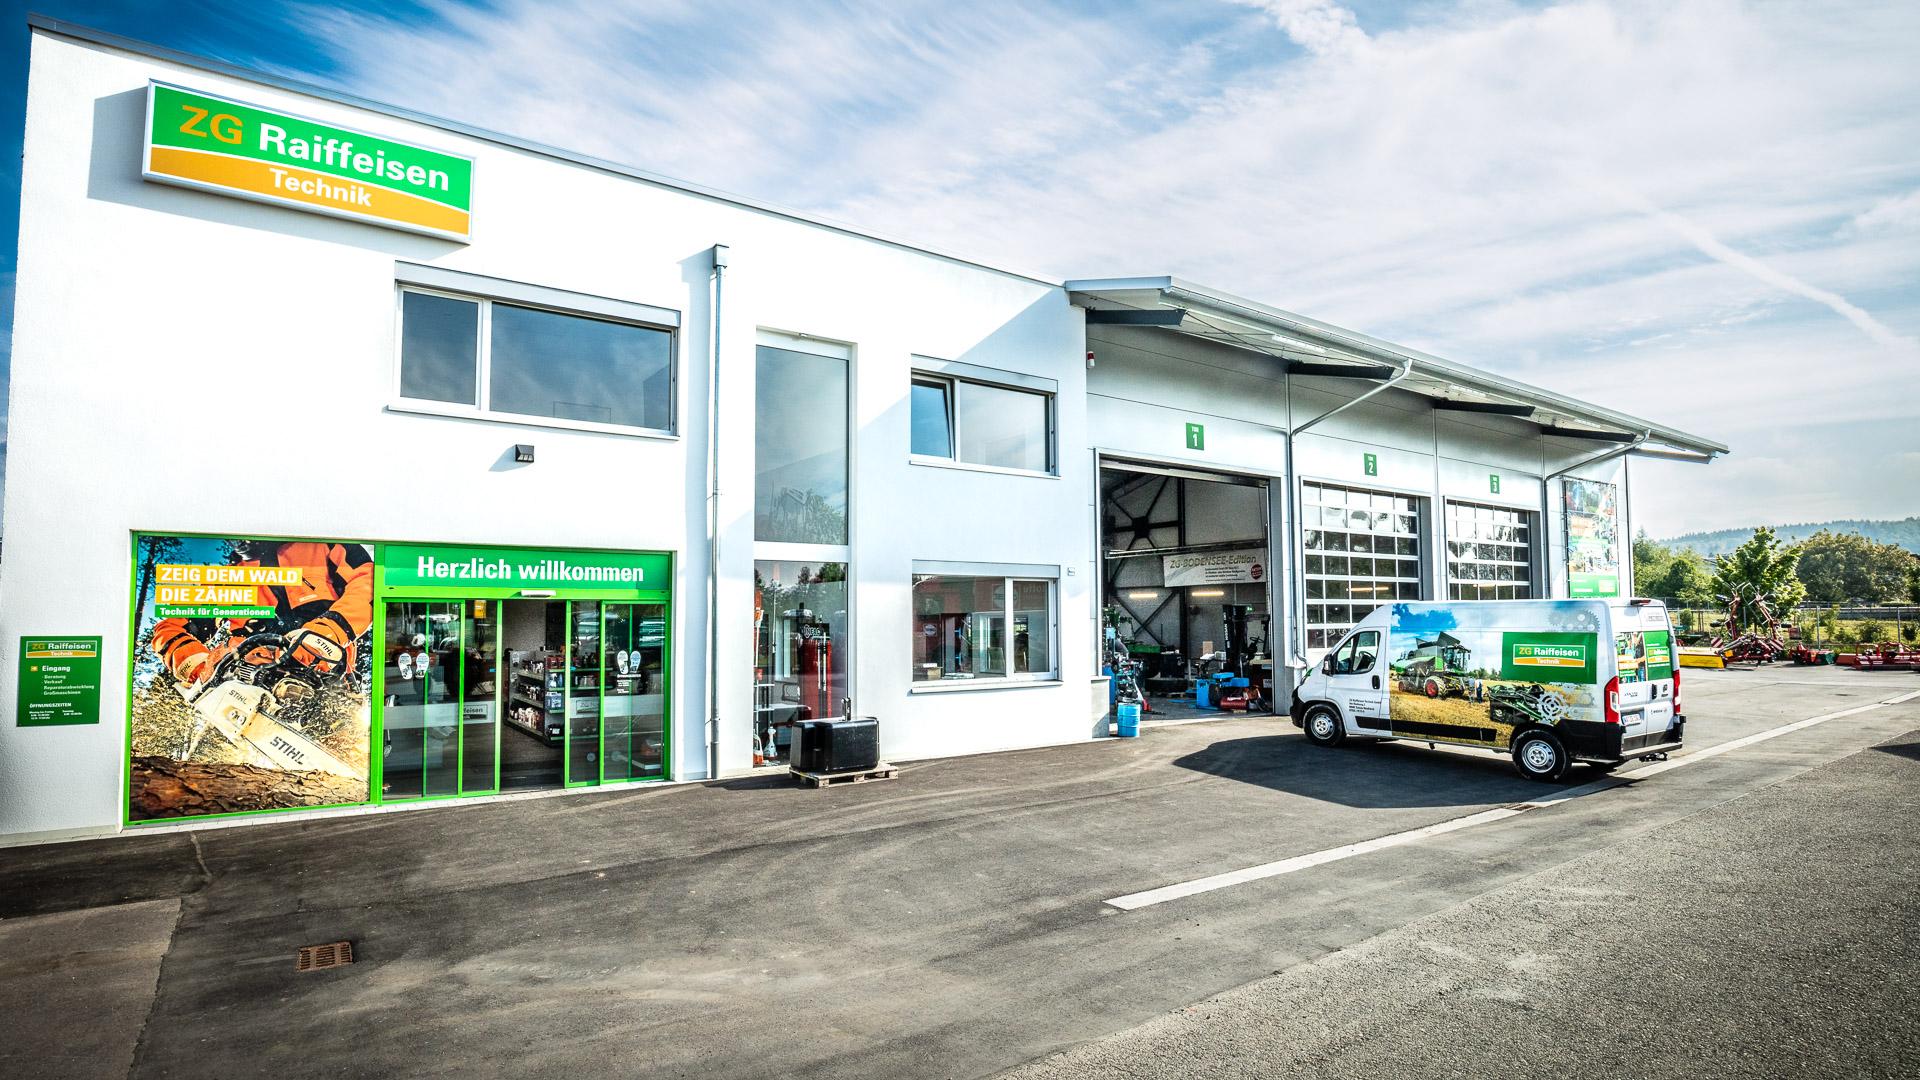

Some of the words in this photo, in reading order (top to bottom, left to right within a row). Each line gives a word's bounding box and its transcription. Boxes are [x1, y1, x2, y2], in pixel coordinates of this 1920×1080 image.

[179, 104, 243, 145] ZG
[259, 122, 449, 191] Raiffeisen
[269, 167, 372, 207] Technik
[1192, 433, 1198, 447] 1
[1368, 461, 1374, 474] 2
[161, 567, 200, 582] ZEIG
[206, 568, 245, 583] DEM
[249, 569, 298, 584] WALD
[417, 555, 511, 580] Herzlich
[518, 560, 644, 582] willkommen
[161, 587, 190, 602] DIE
[194, 585, 253, 603] ZÄHNE
[160, 607, 195, 616] Technik
[198, 607, 210, 616] für
[212, 607, 271, 617] Generationen
[314, 637, 334, 657] STIHL
[1519, 647, 1532, 656] ZG
[1534, 647, 1579, 657] Raiffeisen
[42, 665, 71, 673] Eingang
[1536, 657, 1560, 665] Technik
[228, 689, 247, 705] STIHL
[269, 735, 305, 766] STIHL
